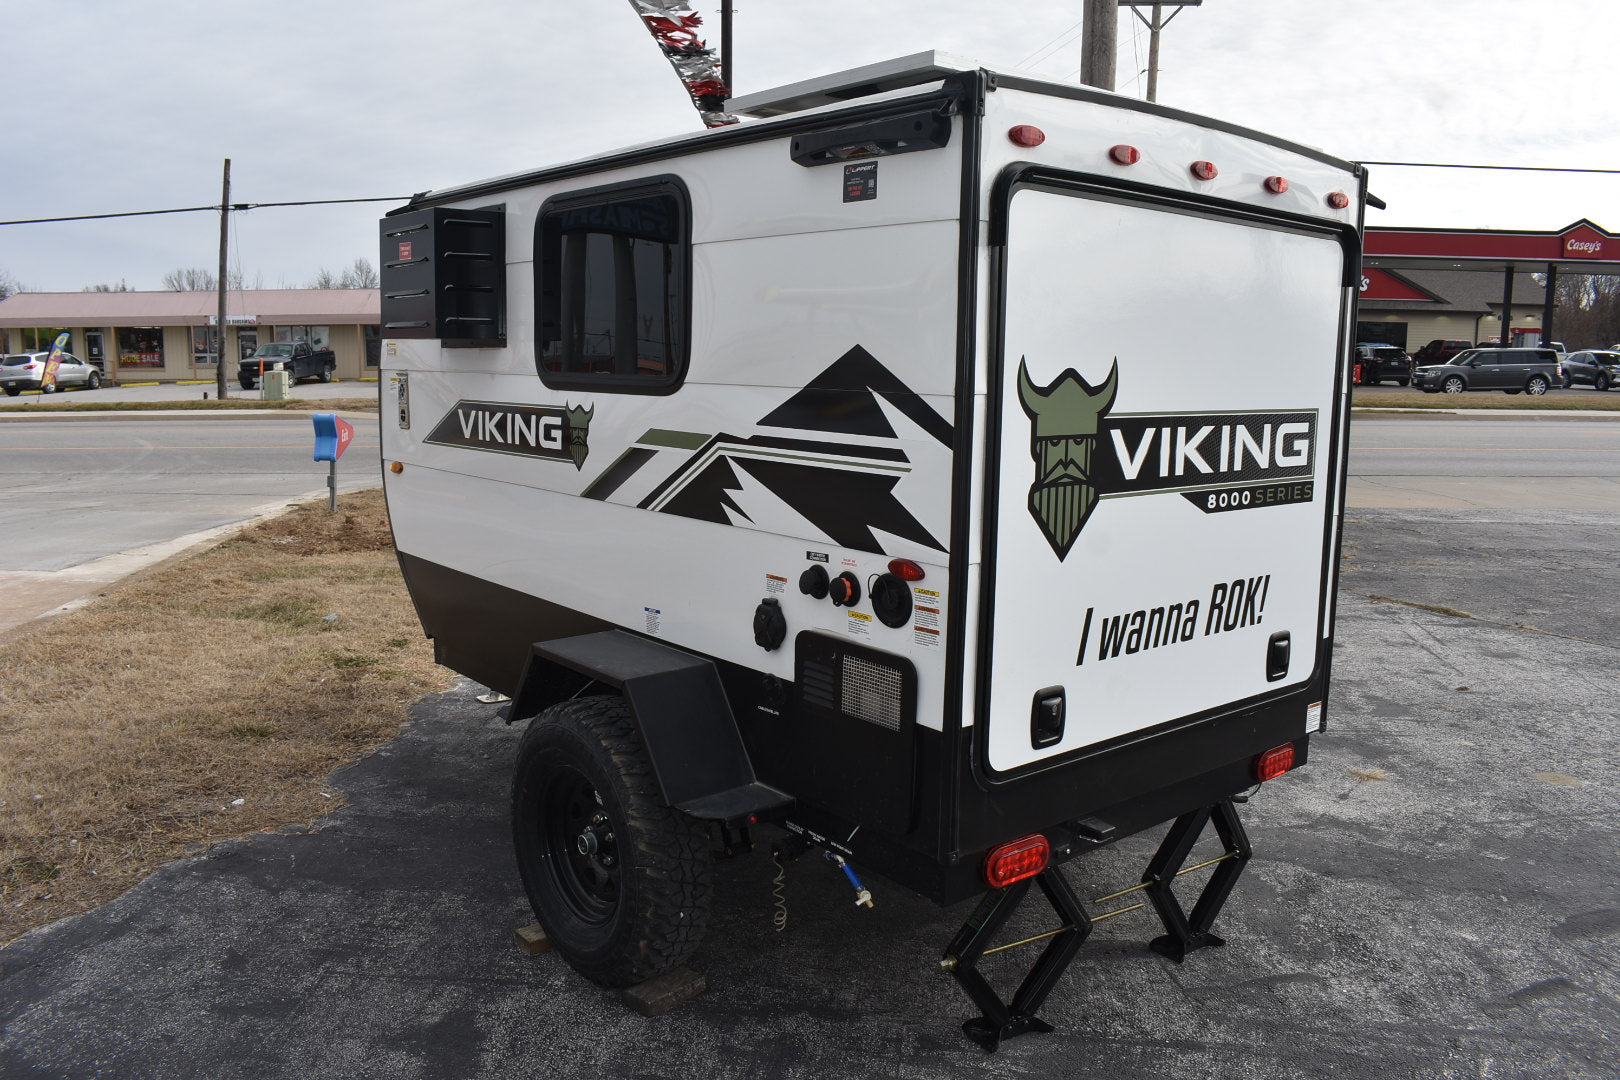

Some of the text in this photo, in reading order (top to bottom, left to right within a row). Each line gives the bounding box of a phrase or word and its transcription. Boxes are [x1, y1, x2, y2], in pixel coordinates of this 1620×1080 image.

[1567, 238, 1602, 254] Casey's
[141, 354, 160, 362] SALE
[457, 408, 563, 451] VIKING
[1110, 422, 1311, 481] VIKING
[1207, 484, 1313, 510] 8000 SERIES
[1076, 574, 1271, 667] I wanna ROK!
